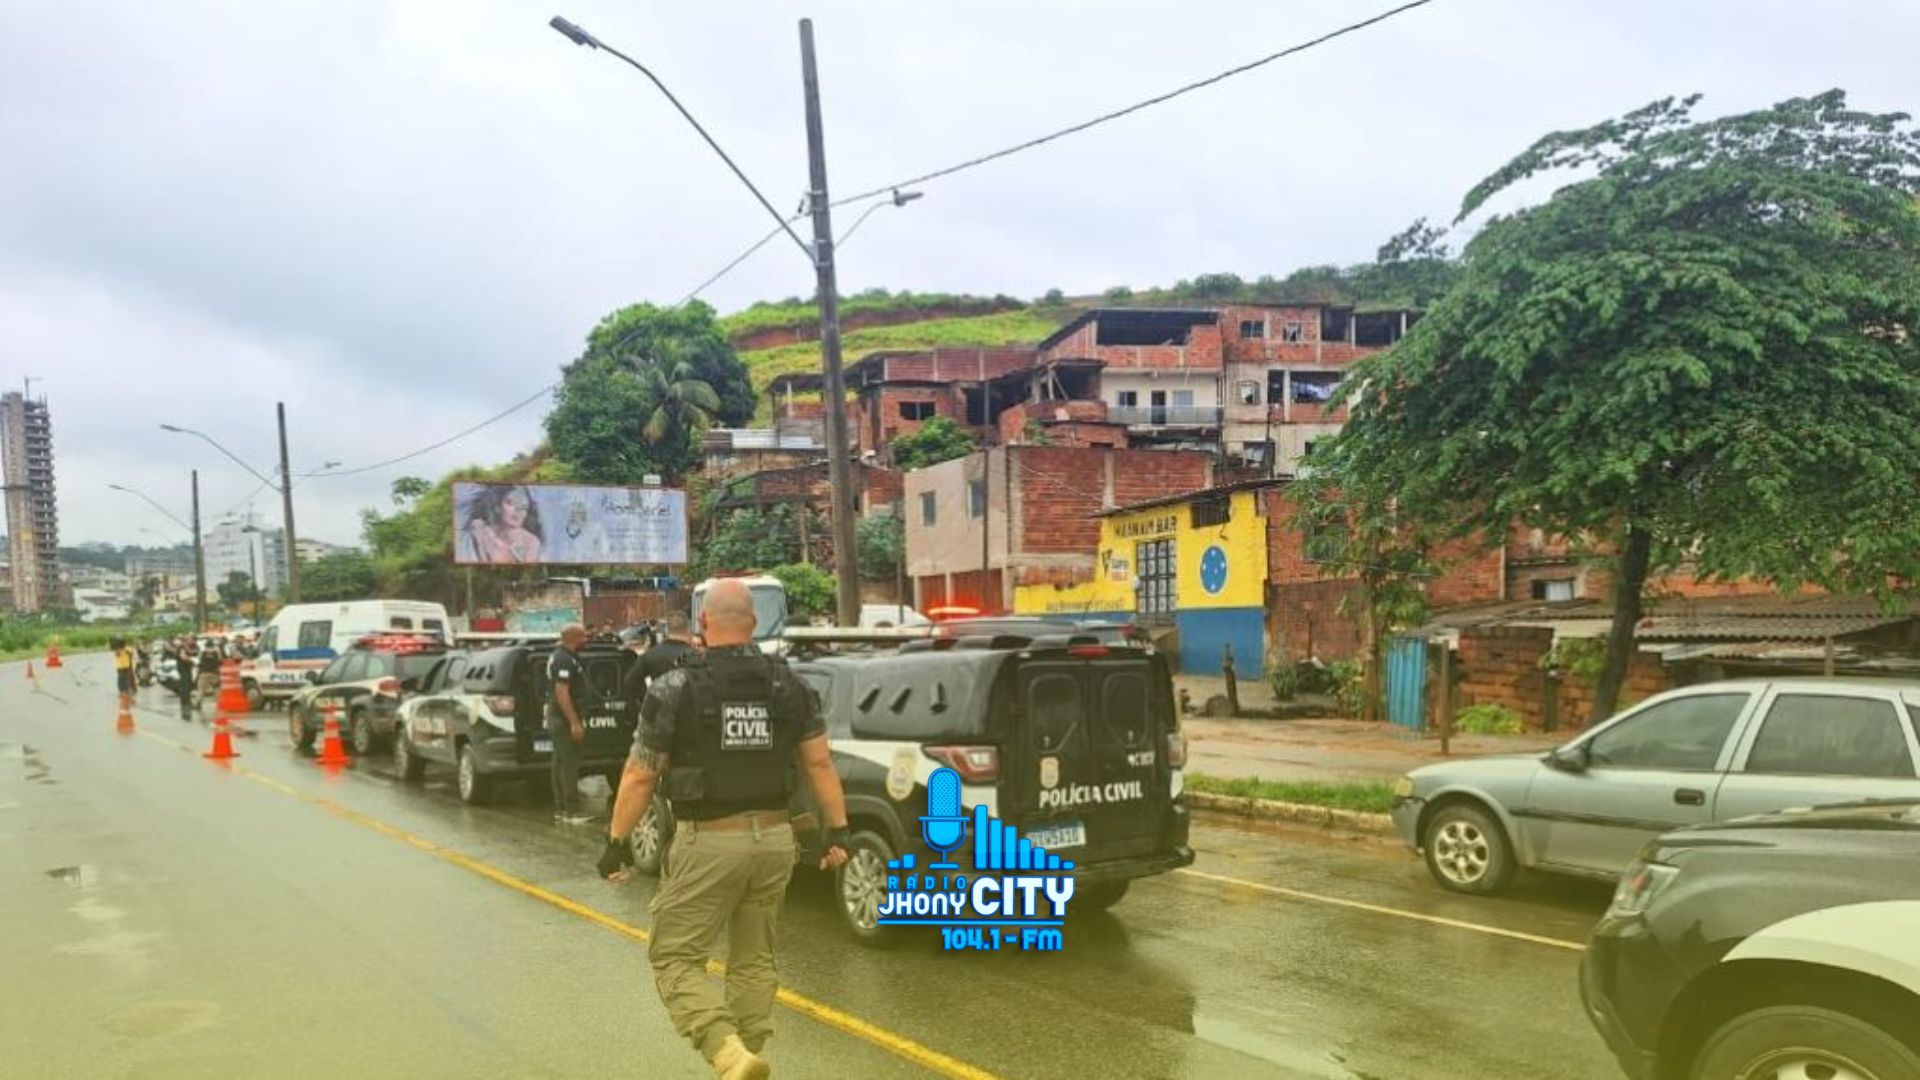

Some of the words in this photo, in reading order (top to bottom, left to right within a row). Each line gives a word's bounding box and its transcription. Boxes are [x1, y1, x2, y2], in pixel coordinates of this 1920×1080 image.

[726, 703, 769, 719] POLÍCIA
[589, 716, 617, 729] CIVIL
[726, 720, 770, 738] CIVIL
[1038, 781, 1102, 808] POLÍCIA
[1104, 780, 1143, 802] CIVIL
